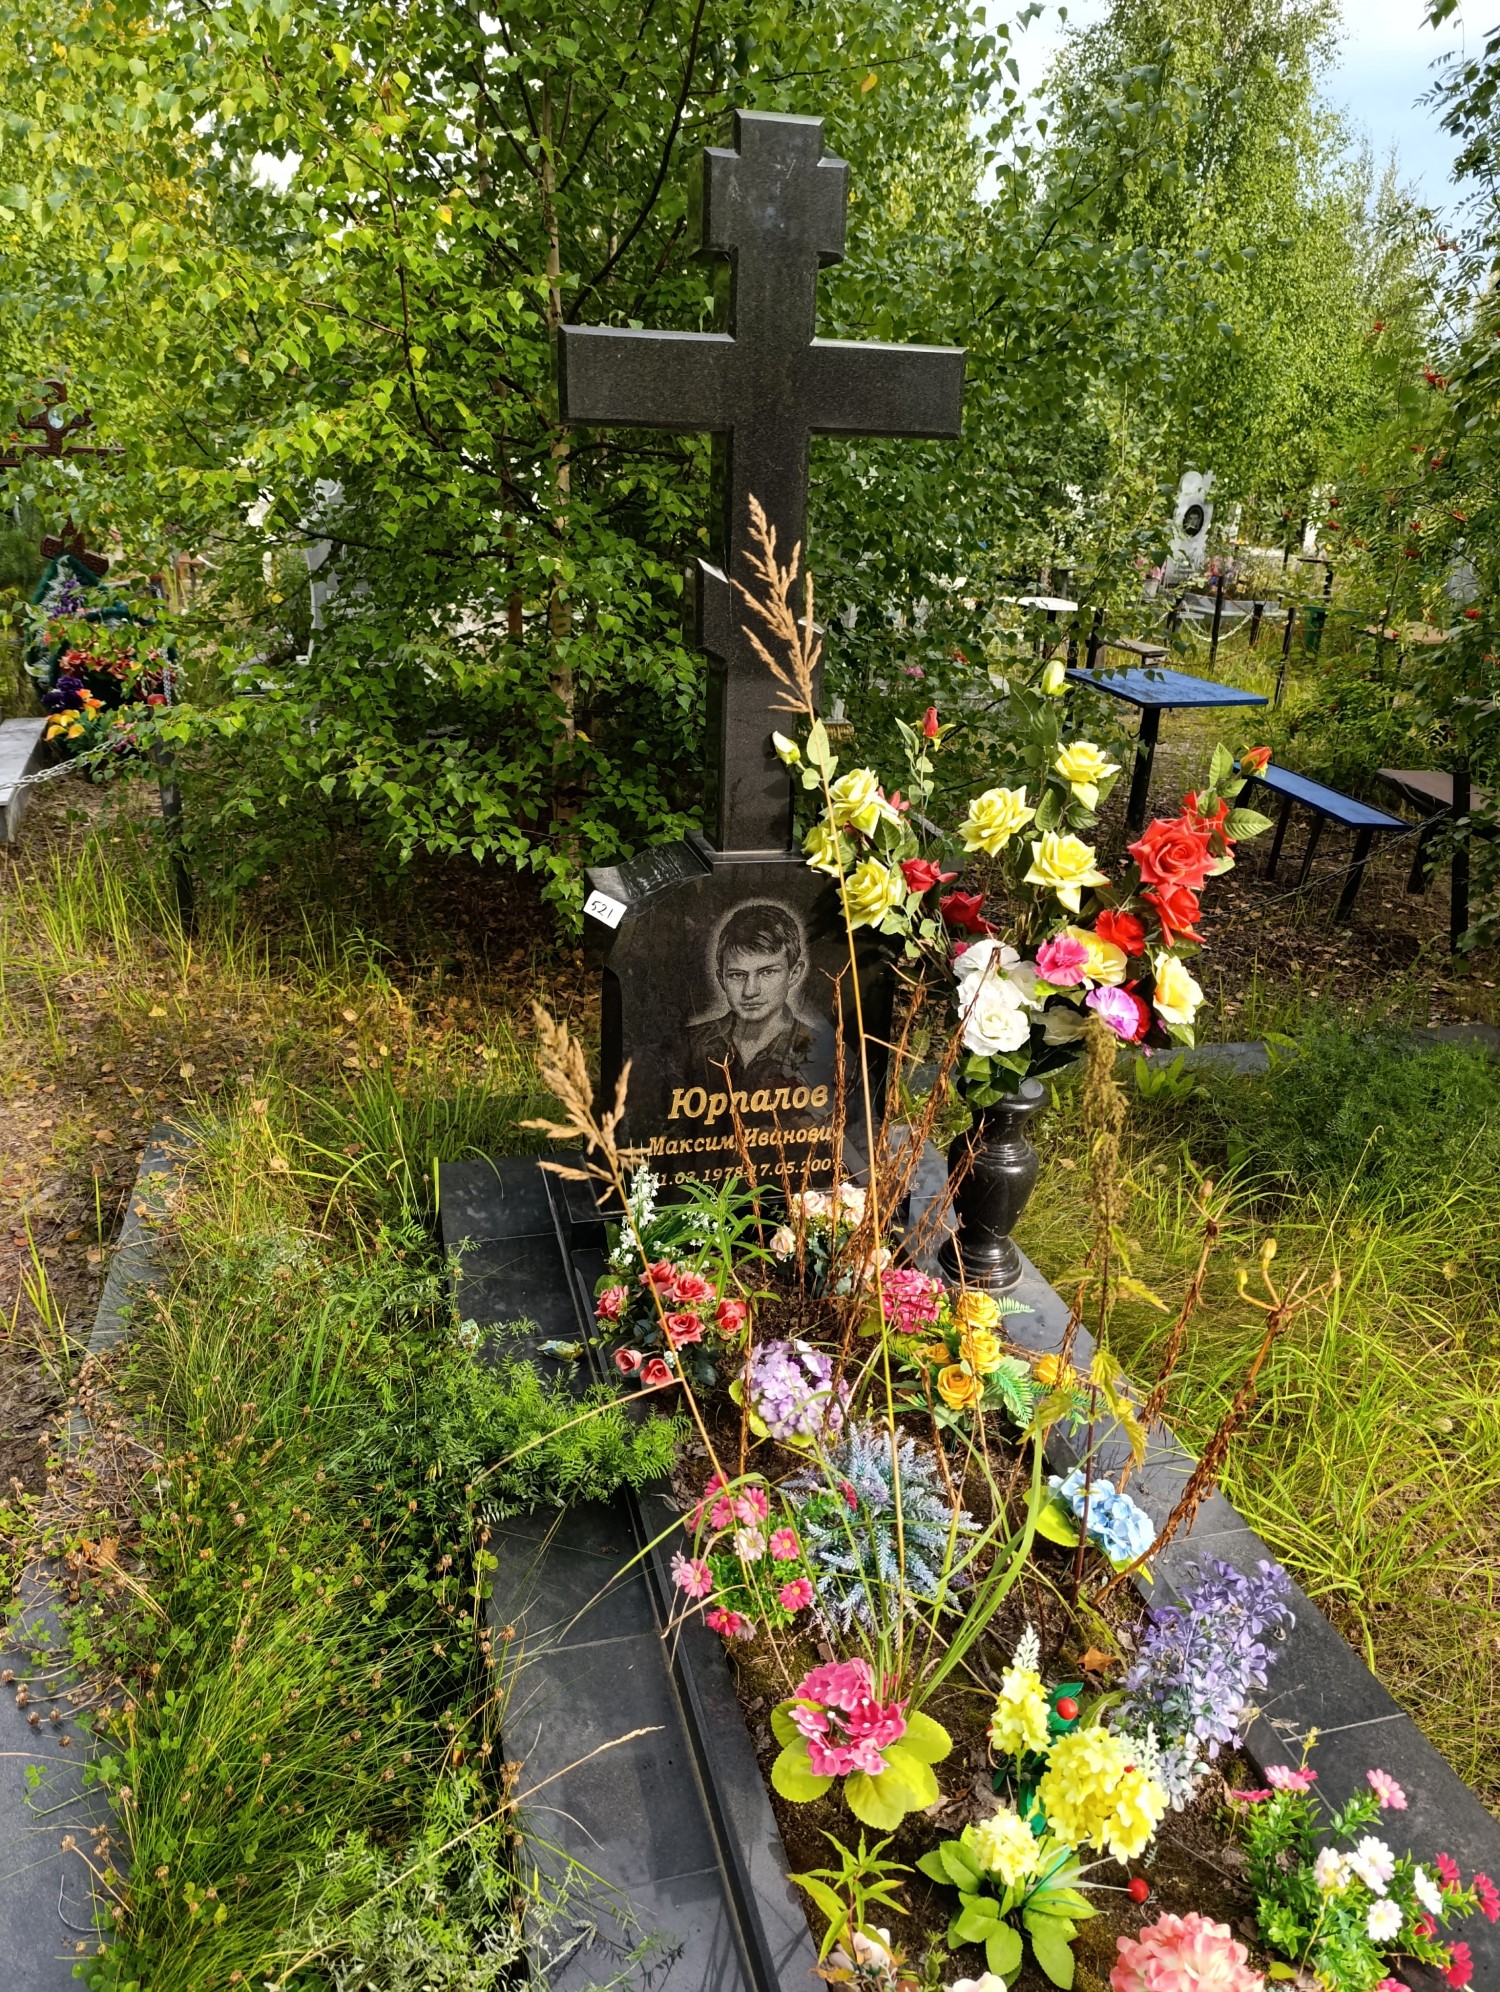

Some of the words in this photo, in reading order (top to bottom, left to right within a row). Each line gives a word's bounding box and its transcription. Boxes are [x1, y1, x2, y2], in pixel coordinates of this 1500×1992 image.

[591, 900, 614, 919] 521
[667, 1084, 829, 1126] Юрпалов
[647, 1134, 736, 1157] Максим
[744, 1125, 844, 1148] Иванови
